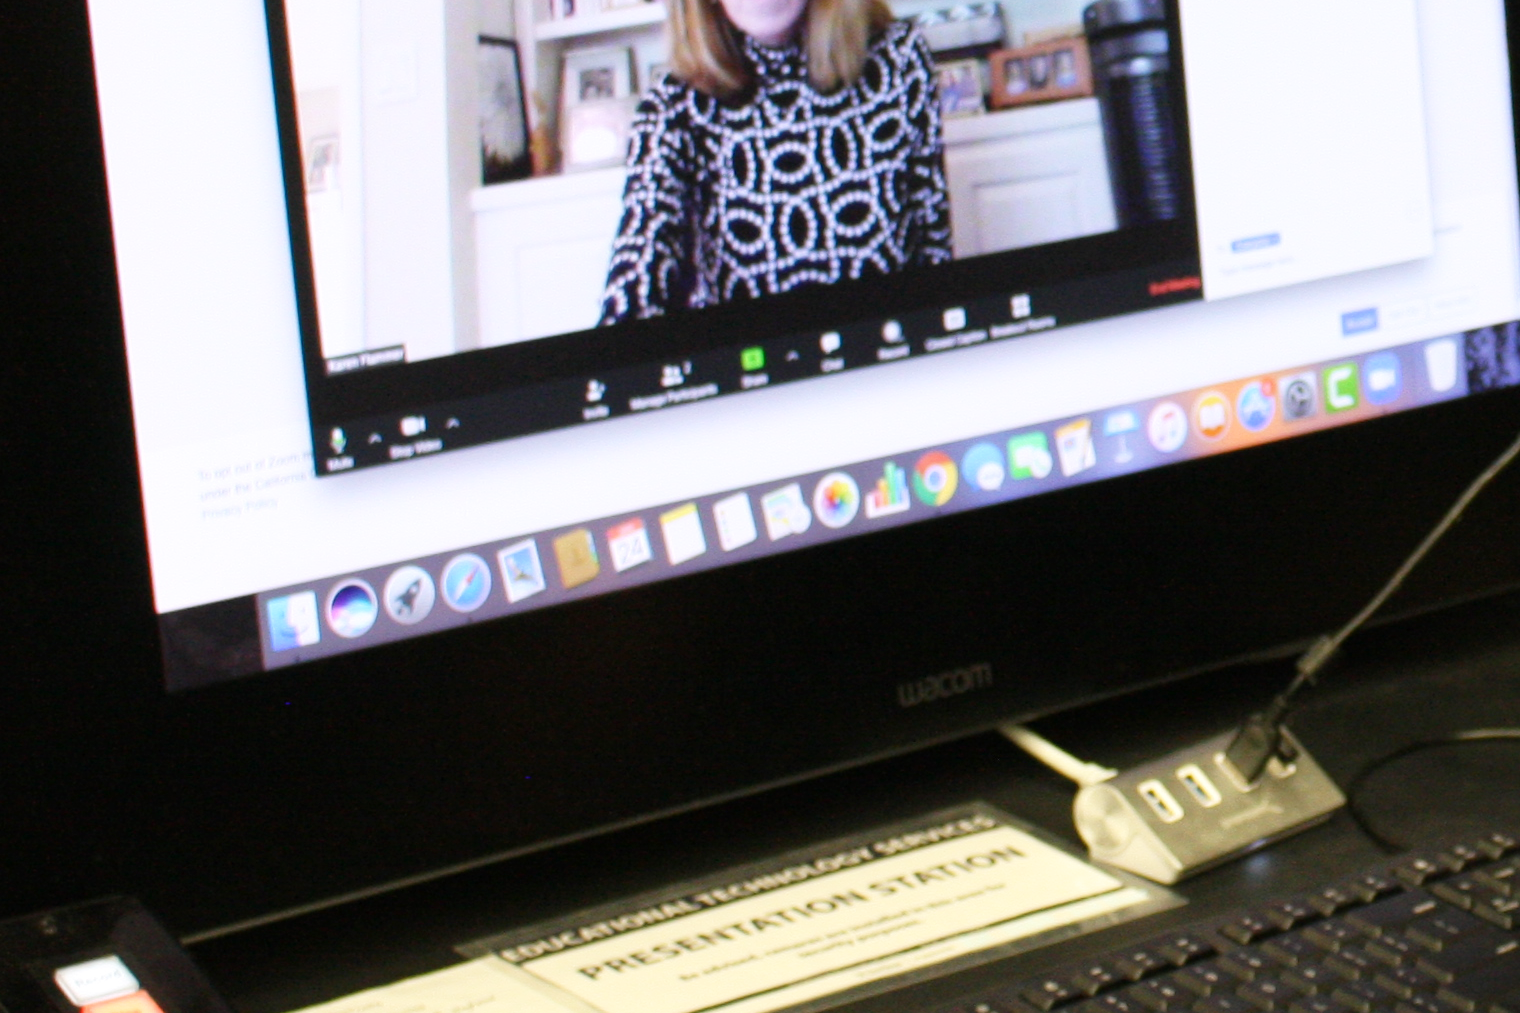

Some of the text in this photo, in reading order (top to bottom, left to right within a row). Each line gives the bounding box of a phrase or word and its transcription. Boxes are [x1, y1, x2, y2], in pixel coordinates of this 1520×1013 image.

[897, 662, 993, 708] wacom
[501, 814, 997, 963] EDUCATIONAL TECHNOLOGY SERVICES
[577, 844, 1027, 981] PRESENTATION STATION
